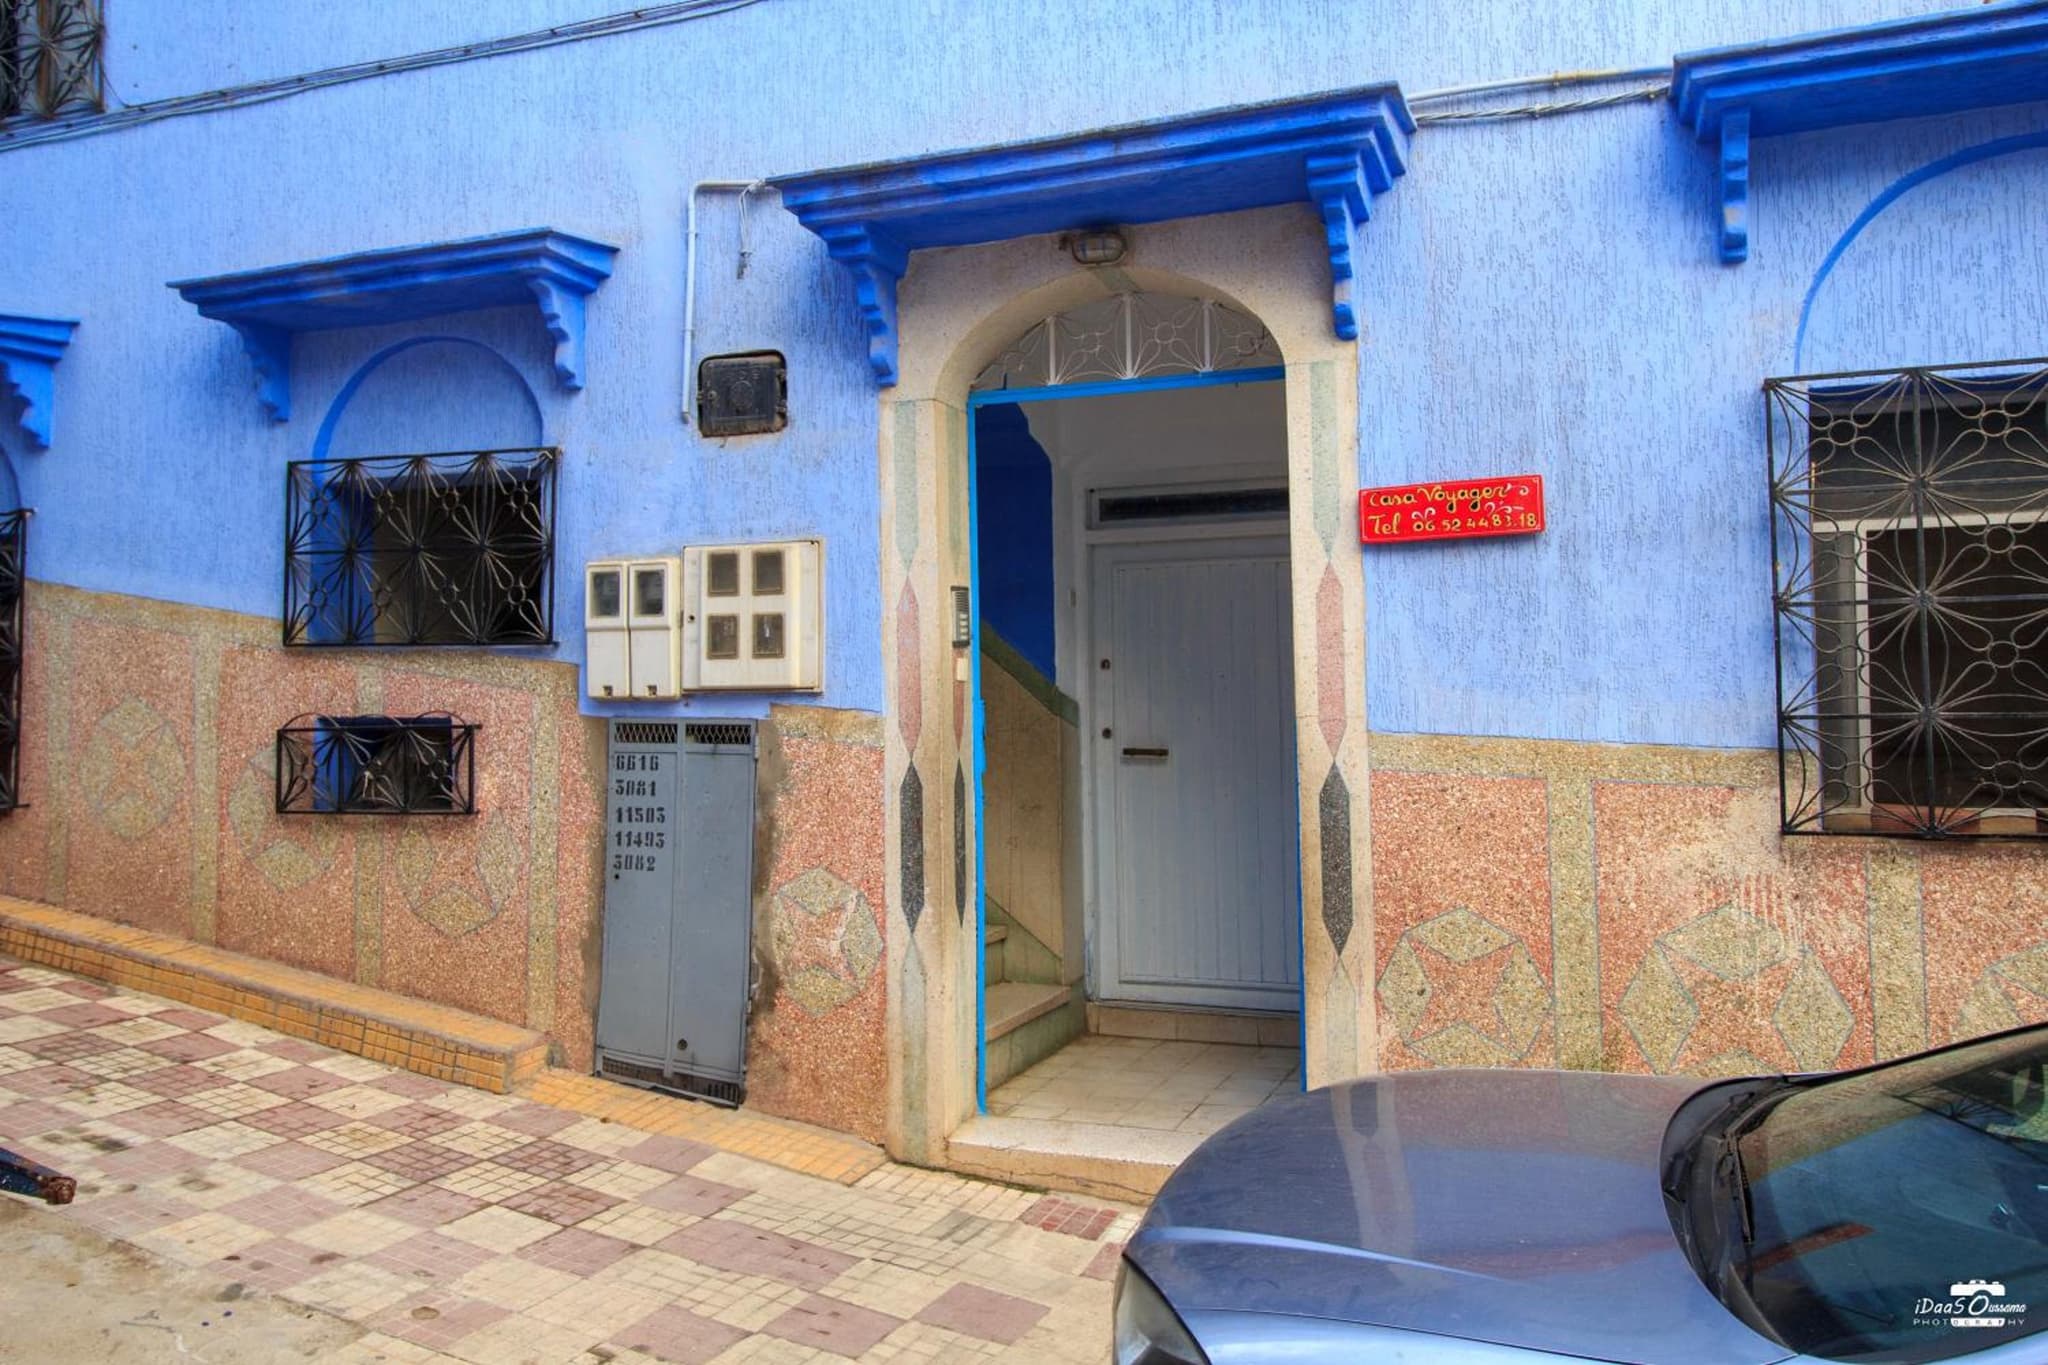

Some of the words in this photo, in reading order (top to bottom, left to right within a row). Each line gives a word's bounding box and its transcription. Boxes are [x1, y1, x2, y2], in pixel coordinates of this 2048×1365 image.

[1368, 512, 1401, 535] Tel
[615, 780, 656, 796] 3081
[616, 807, 665, 823] 11503
[615, 831, 665, 848] 11493
